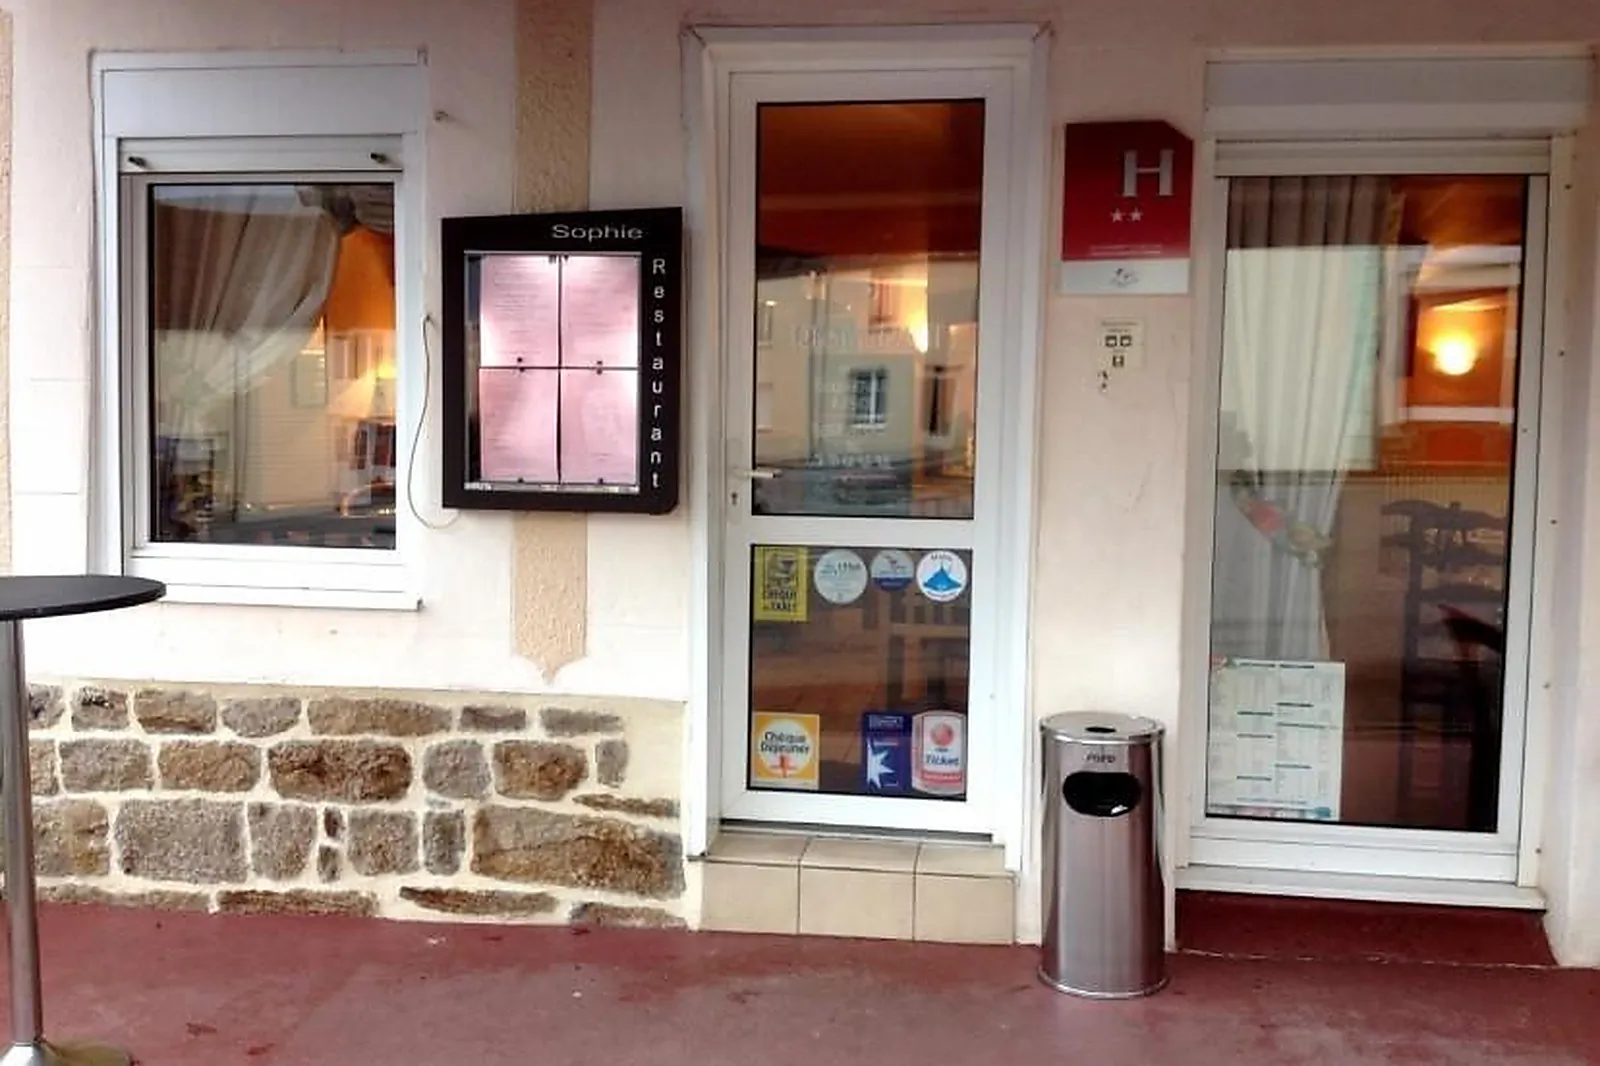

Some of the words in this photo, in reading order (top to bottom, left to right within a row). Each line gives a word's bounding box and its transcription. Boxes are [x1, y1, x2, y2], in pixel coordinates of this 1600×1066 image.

[1122, 149, 1175, 198] H
[551, 223, 643, 243] Sophie
[650, 257, 667, 490] Restaurant
